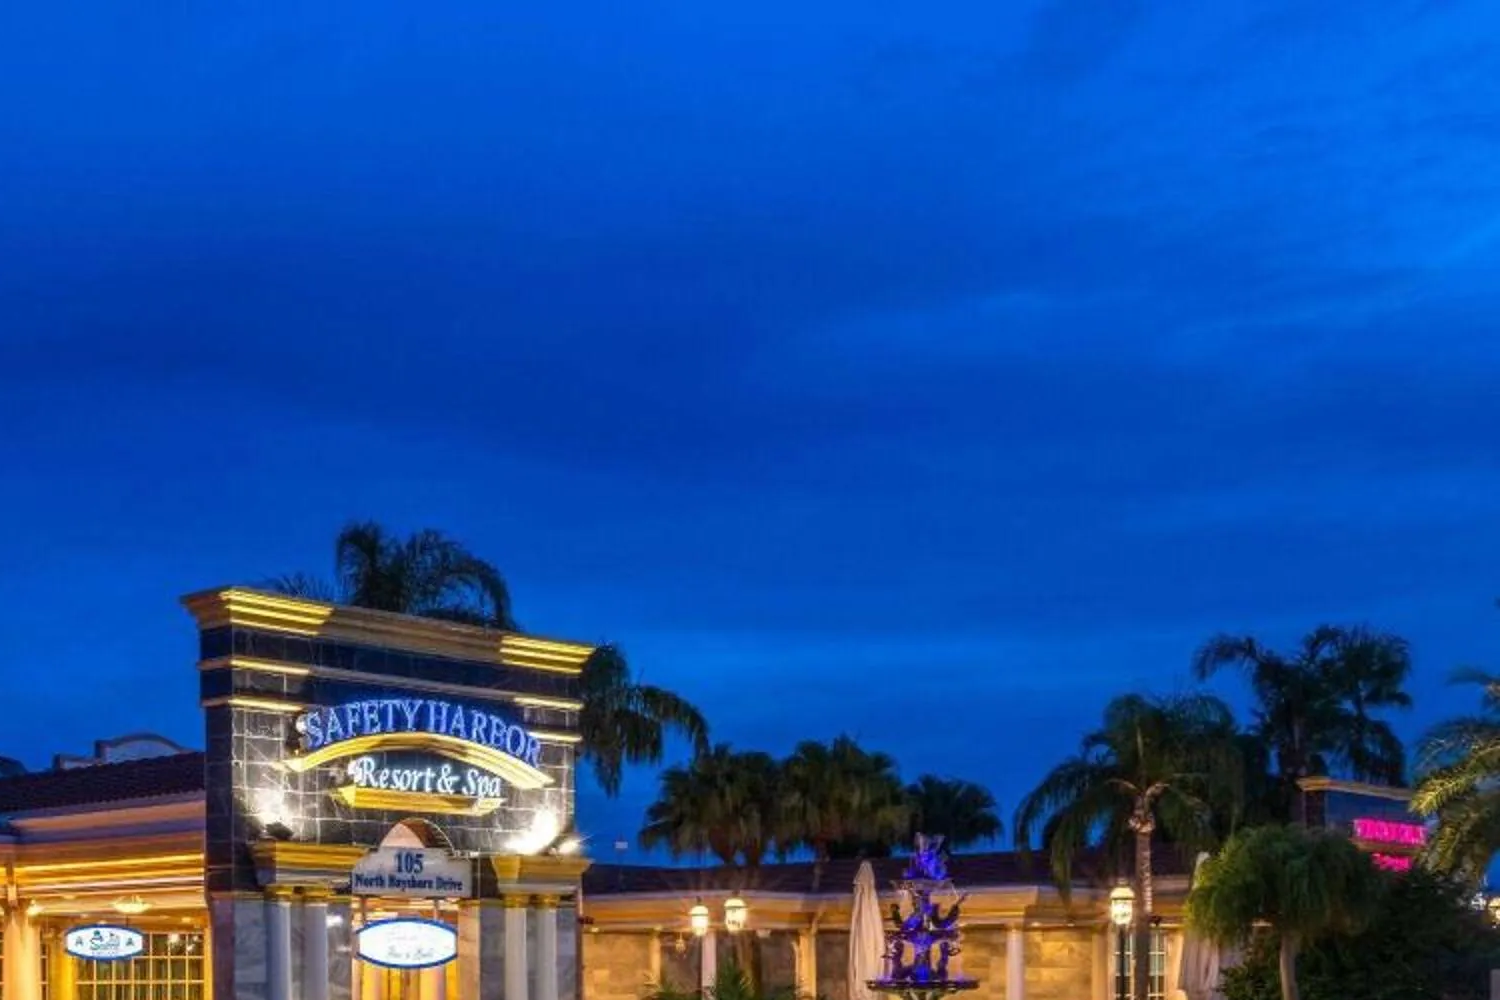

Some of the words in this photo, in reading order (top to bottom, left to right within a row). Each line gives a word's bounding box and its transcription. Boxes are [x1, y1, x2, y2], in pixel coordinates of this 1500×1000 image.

[304, 699, 424, 748] SAFETY
[428, 701, 543, 768] HARBOR
[354, 756, 436, 792] Resort
[437, 763, 460, 794] &
[462, 768, 501, 799] Spa
[394, 852, 424, 873] 105
[355, 874, 385, 888] North
[435, 876, 463, 891] Drive
